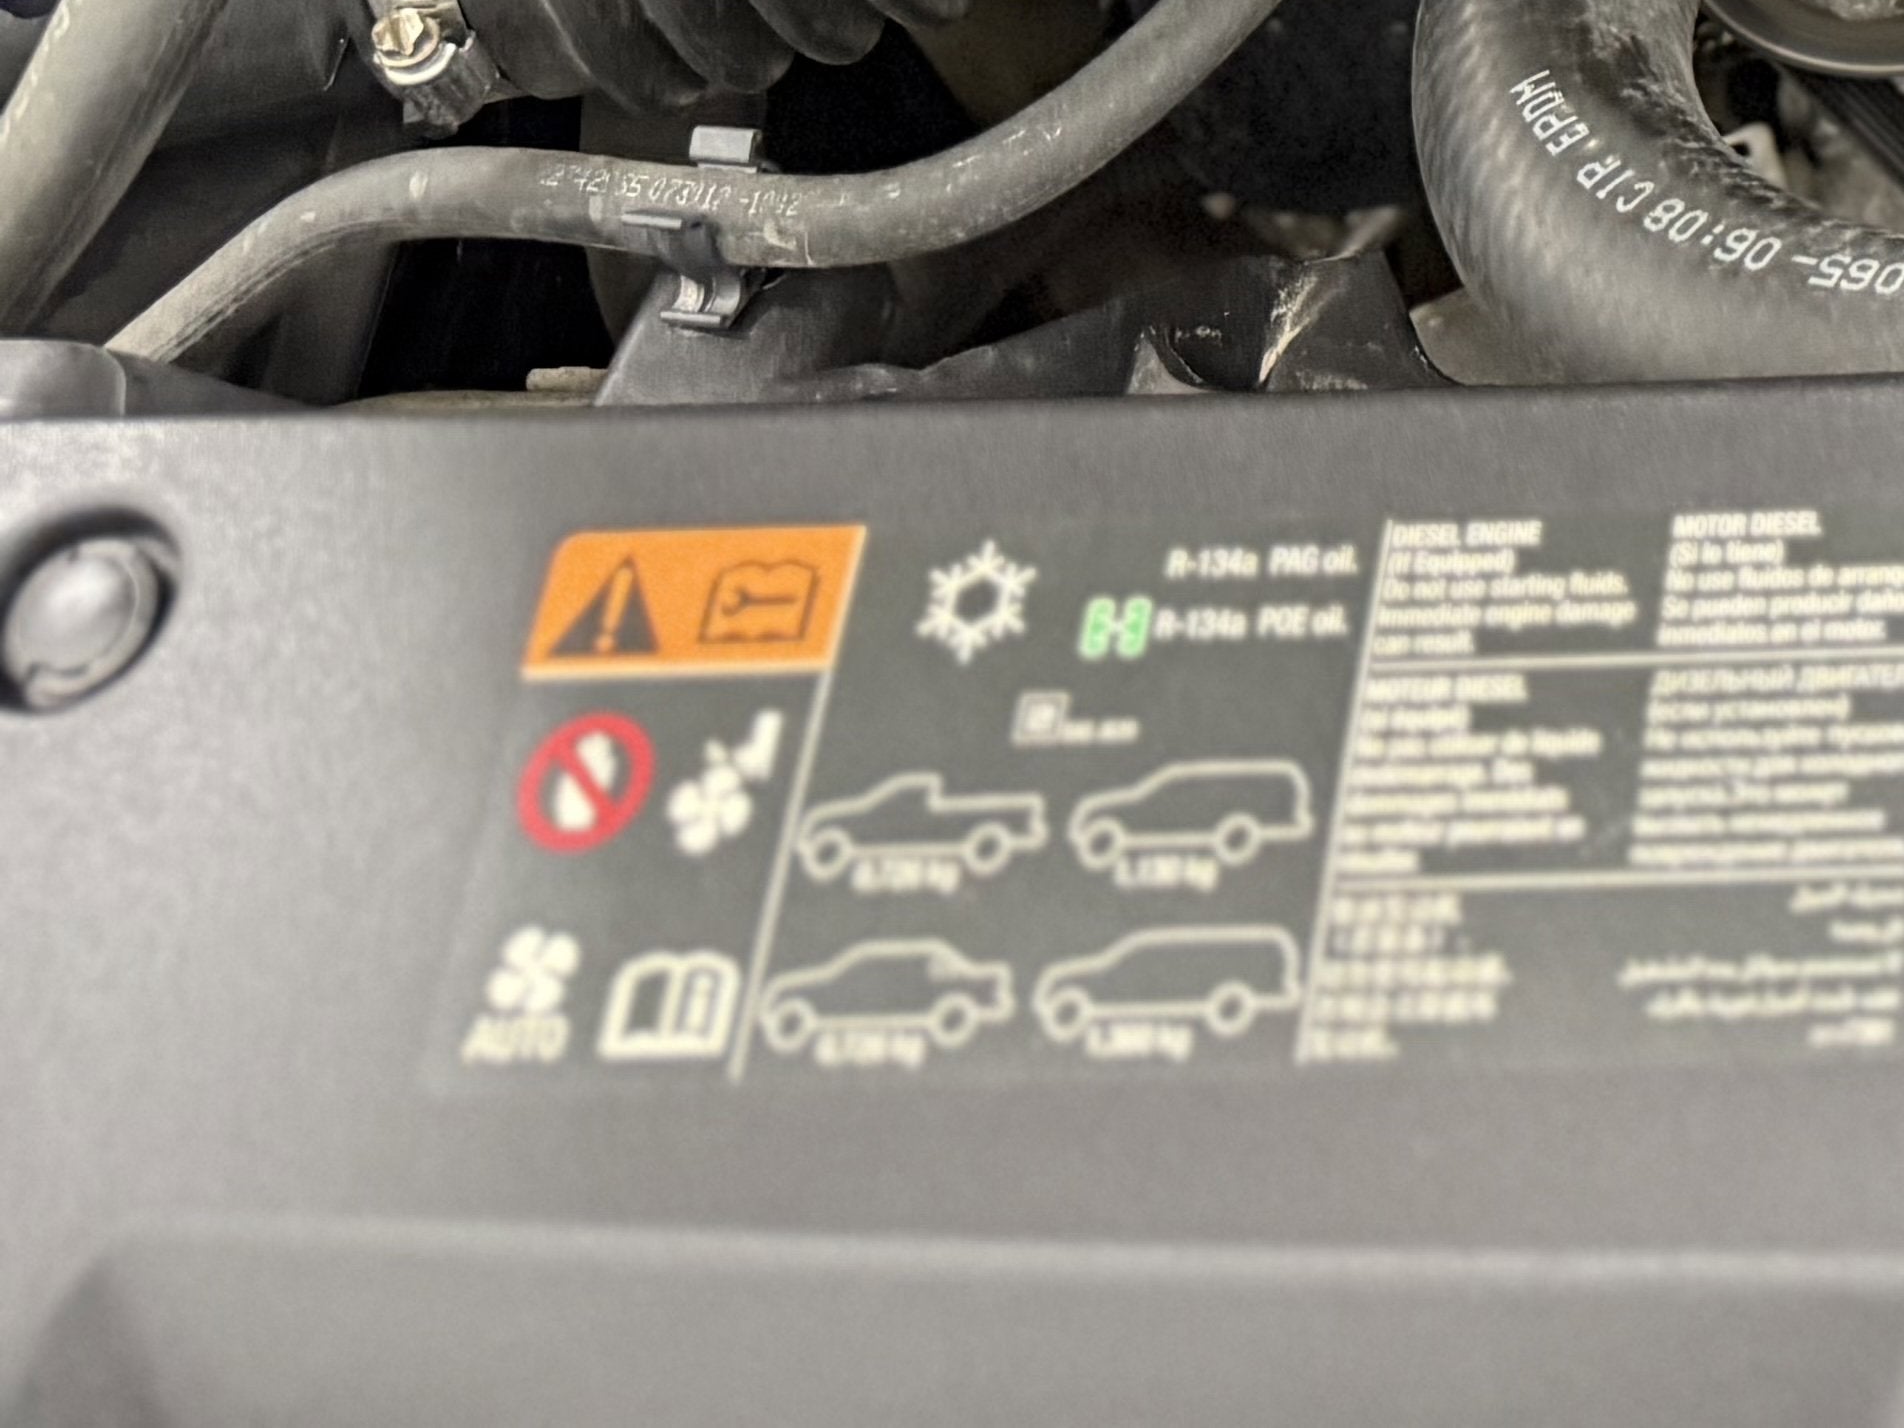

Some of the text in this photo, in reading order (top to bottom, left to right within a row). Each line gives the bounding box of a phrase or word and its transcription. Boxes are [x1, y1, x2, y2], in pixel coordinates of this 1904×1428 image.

[1509, 68, 1590, 157] EPDM
[1642, 197, 1783, 272] 06:08
[1393, 519, 1543, 548] DIESEL ENGINE
[1672, 509, 1823, 538] MOTOR DIESEL
[1164, 546, 1259, 578] R-134a
[1267, 546, 1320, 576] PAG
[1153, 608, 1248, 640] R-134a
